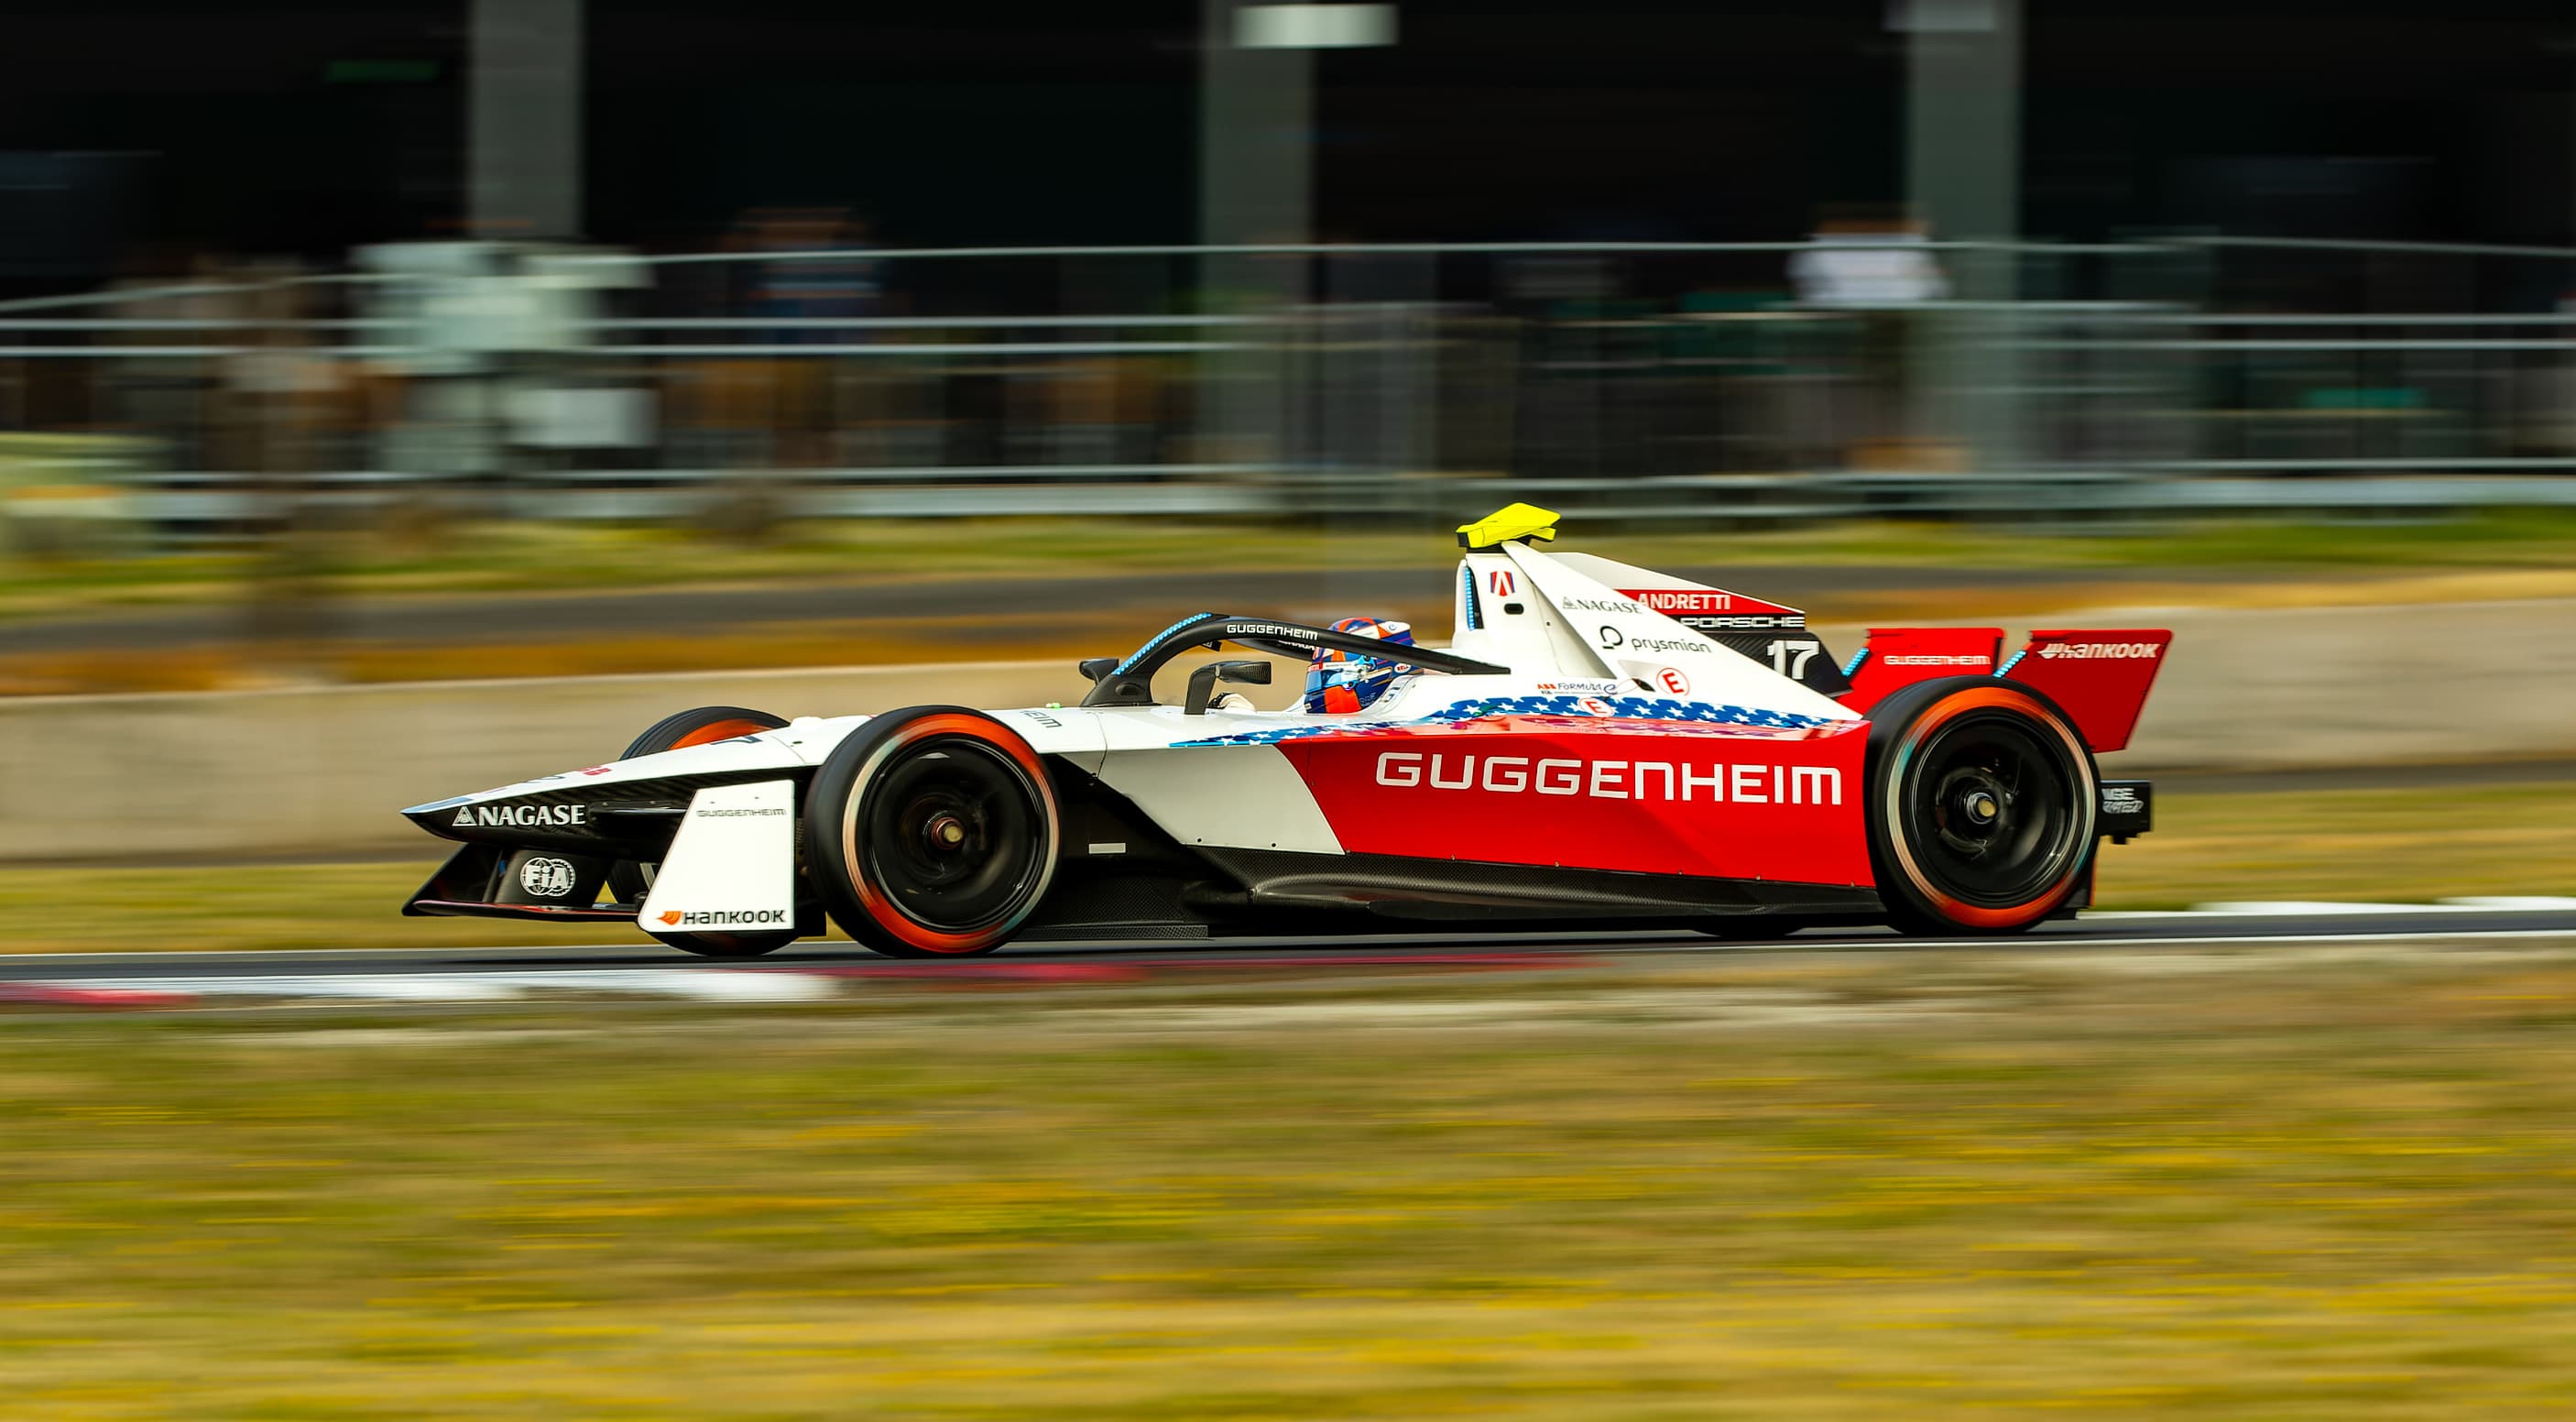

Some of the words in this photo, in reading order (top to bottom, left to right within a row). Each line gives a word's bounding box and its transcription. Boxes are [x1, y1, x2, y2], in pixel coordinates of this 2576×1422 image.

[1576, 599, 1643, 615] NAGASE
[1637, 593, 1731, 611] ANDRETTI
[1680, 617, 1806, 629] PORSCHE
[1228, 625, 1318, 640] GUGGENHEIM
[1632, 636, 1712, 653] prysmian
[1767, 640, 1819, 680] 17
[1558, 683, 1602, 691] FORMULA
[1375, 750, 1842, 806] GUGGENHEIM
[478, 804, 586, 826] NAGASE
[697, 808, 787, 817] GUGGENHEIM
[525, 864, 569, 890] FIA
